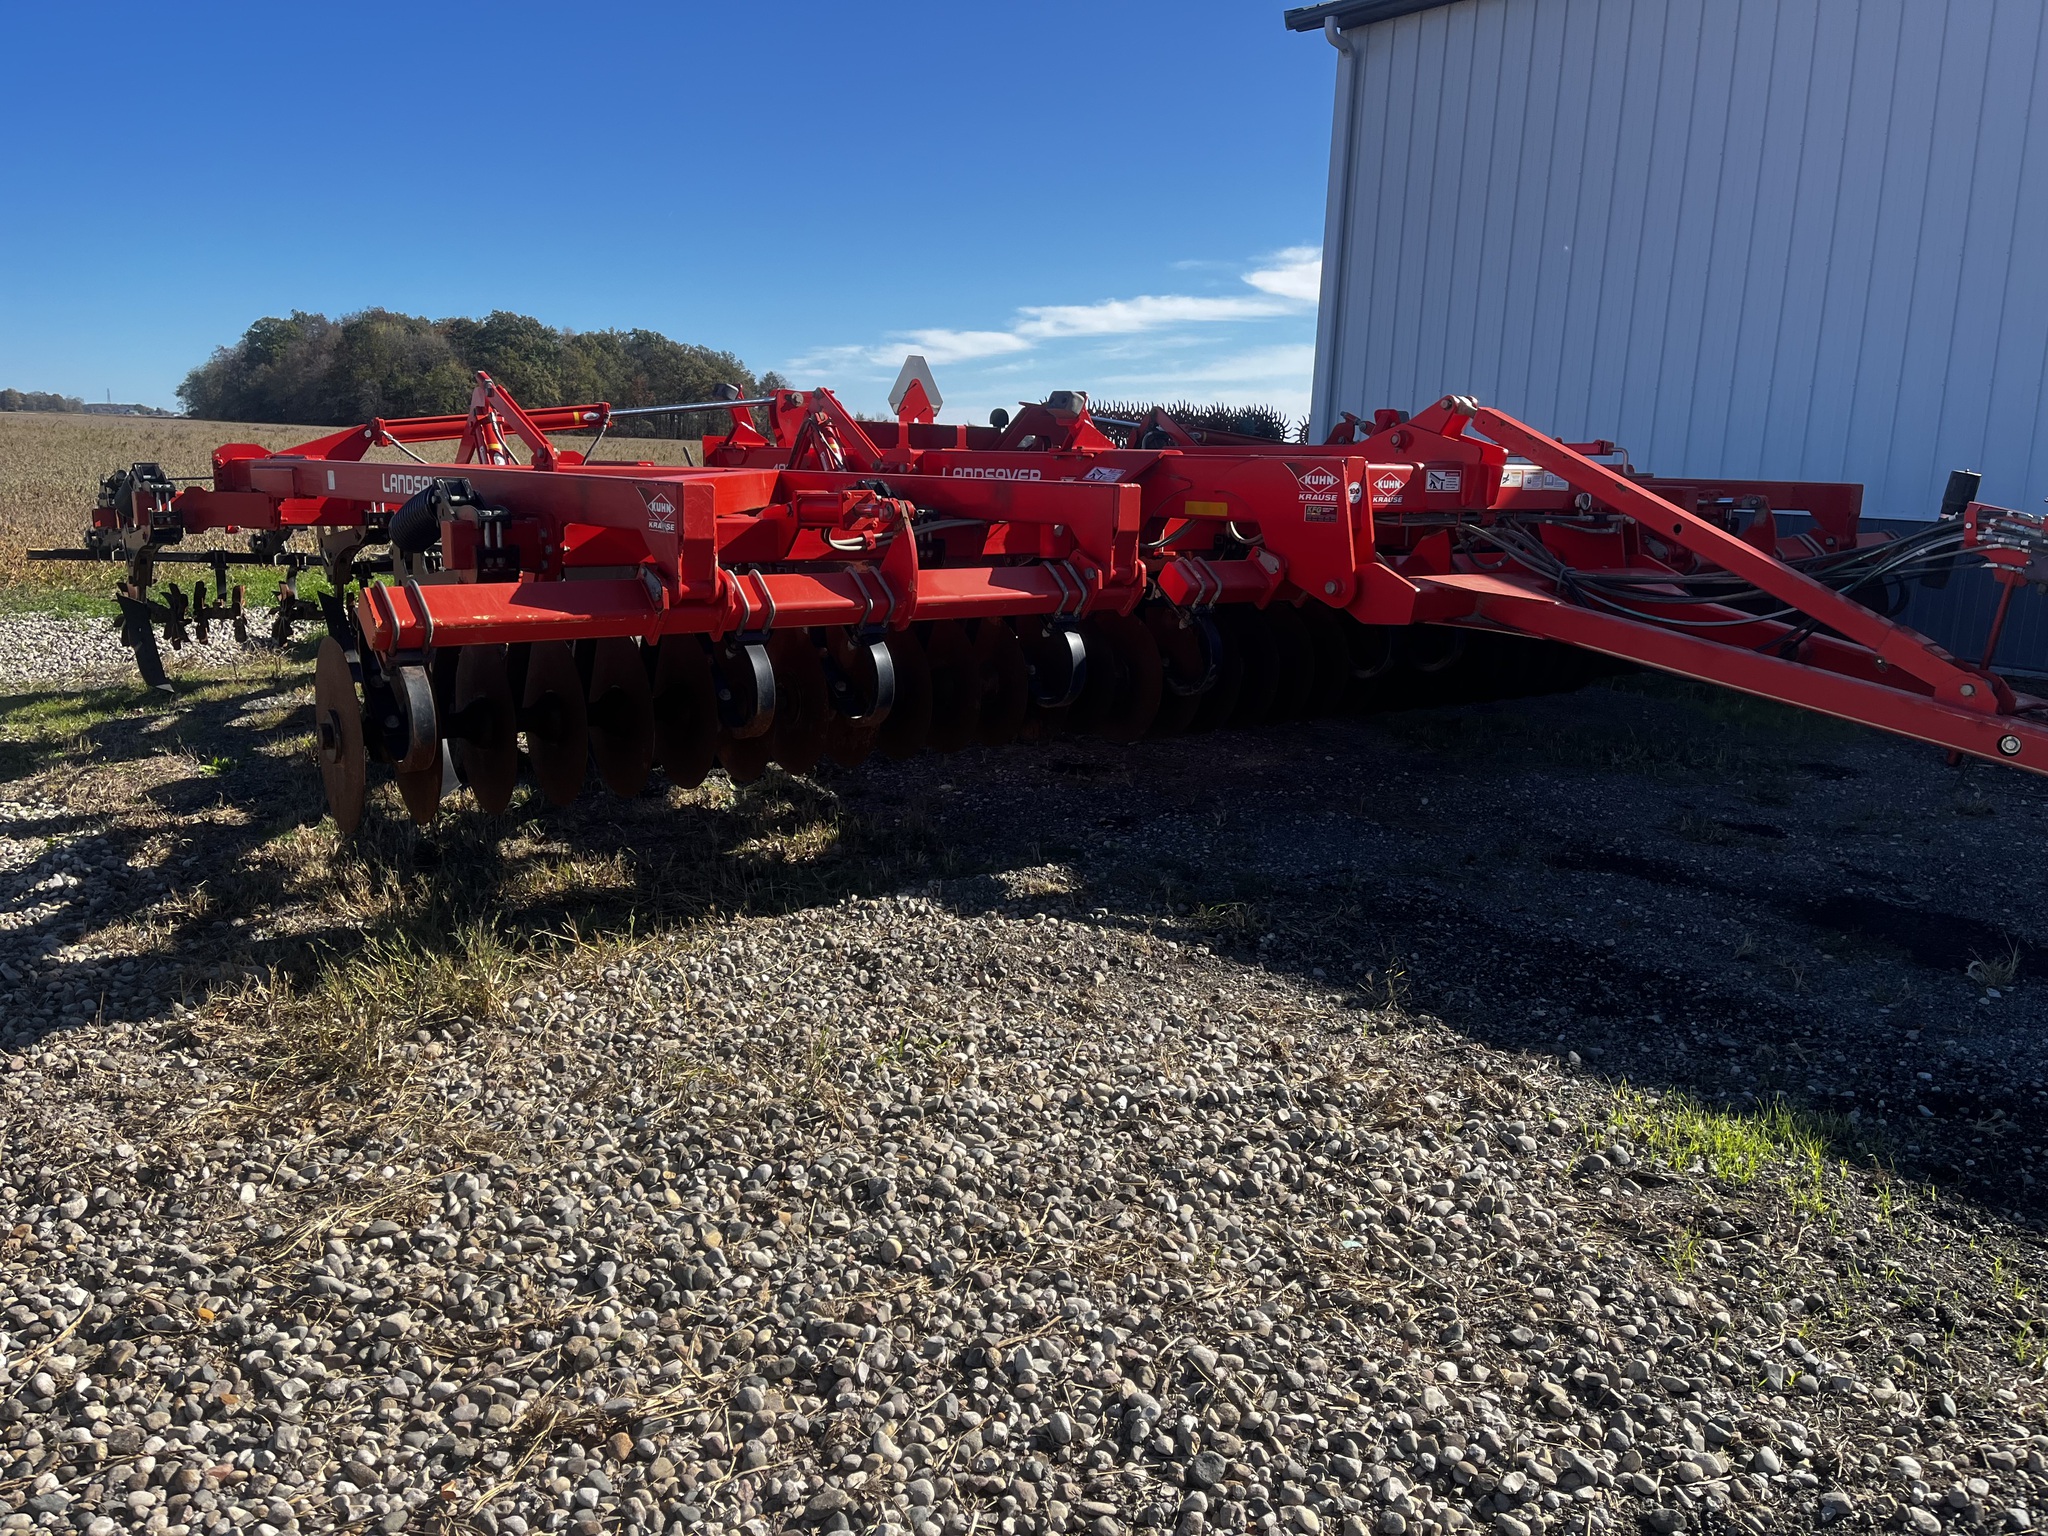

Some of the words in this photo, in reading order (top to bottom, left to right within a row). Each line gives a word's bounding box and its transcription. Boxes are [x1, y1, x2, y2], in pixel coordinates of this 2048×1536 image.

[1304, 475, 1334, 485] KUHN
[1377, 480, 1401, 489] KUHN
[1298, 493, 1338, 502] KRAUSE
[651, 502, 671, 513] KUHN
